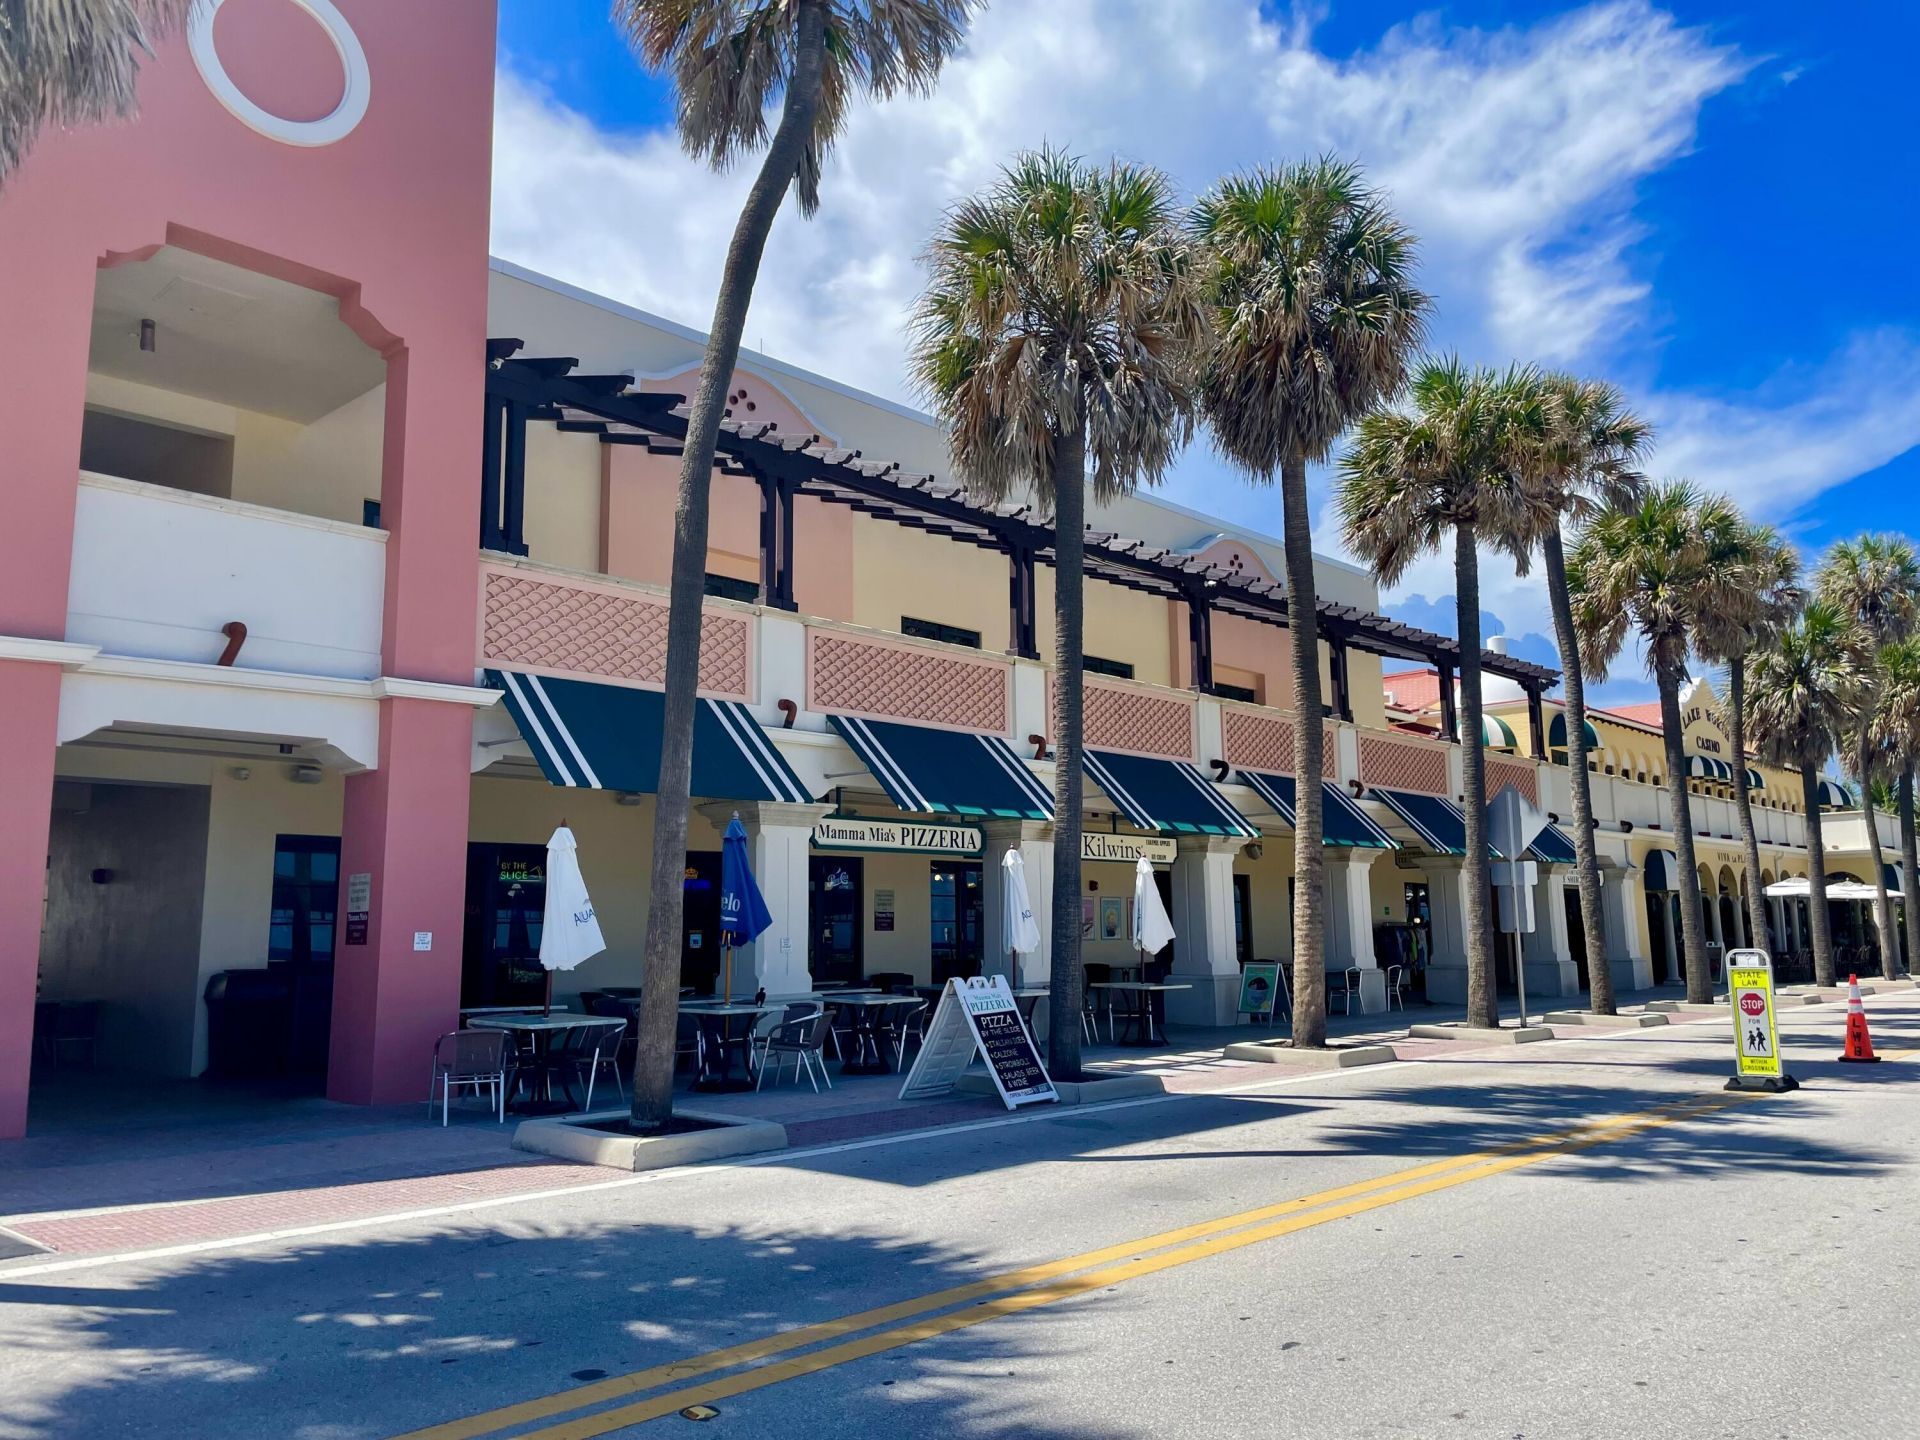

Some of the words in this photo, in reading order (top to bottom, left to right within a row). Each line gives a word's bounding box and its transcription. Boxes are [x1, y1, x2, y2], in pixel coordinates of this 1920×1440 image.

[1682, 707, 1701, 730] LAKE
[1696, 735, 1720, 754] CASINO
[817, 824, 866, 841] Mamma
[869, 827, 896, 843] Mia's
[901, 826, 977, 850] PIZZERIA
[1082, 835, 1142, 860] Kilwins
[501, 862, 511, 870] BY
[513, 862, 527, 870] THE
[500, 871, 529, 880] SLICE
[1737, 971, 1761, 979] STATE
[970, 999, 1012, 1012] PIZZERIA
[1741, 999, 1764, 1009] STOP
[981, 1014, 1014, 1028] PIZZA
[1744, 1064, 1774, 1072] CROSSWALK
